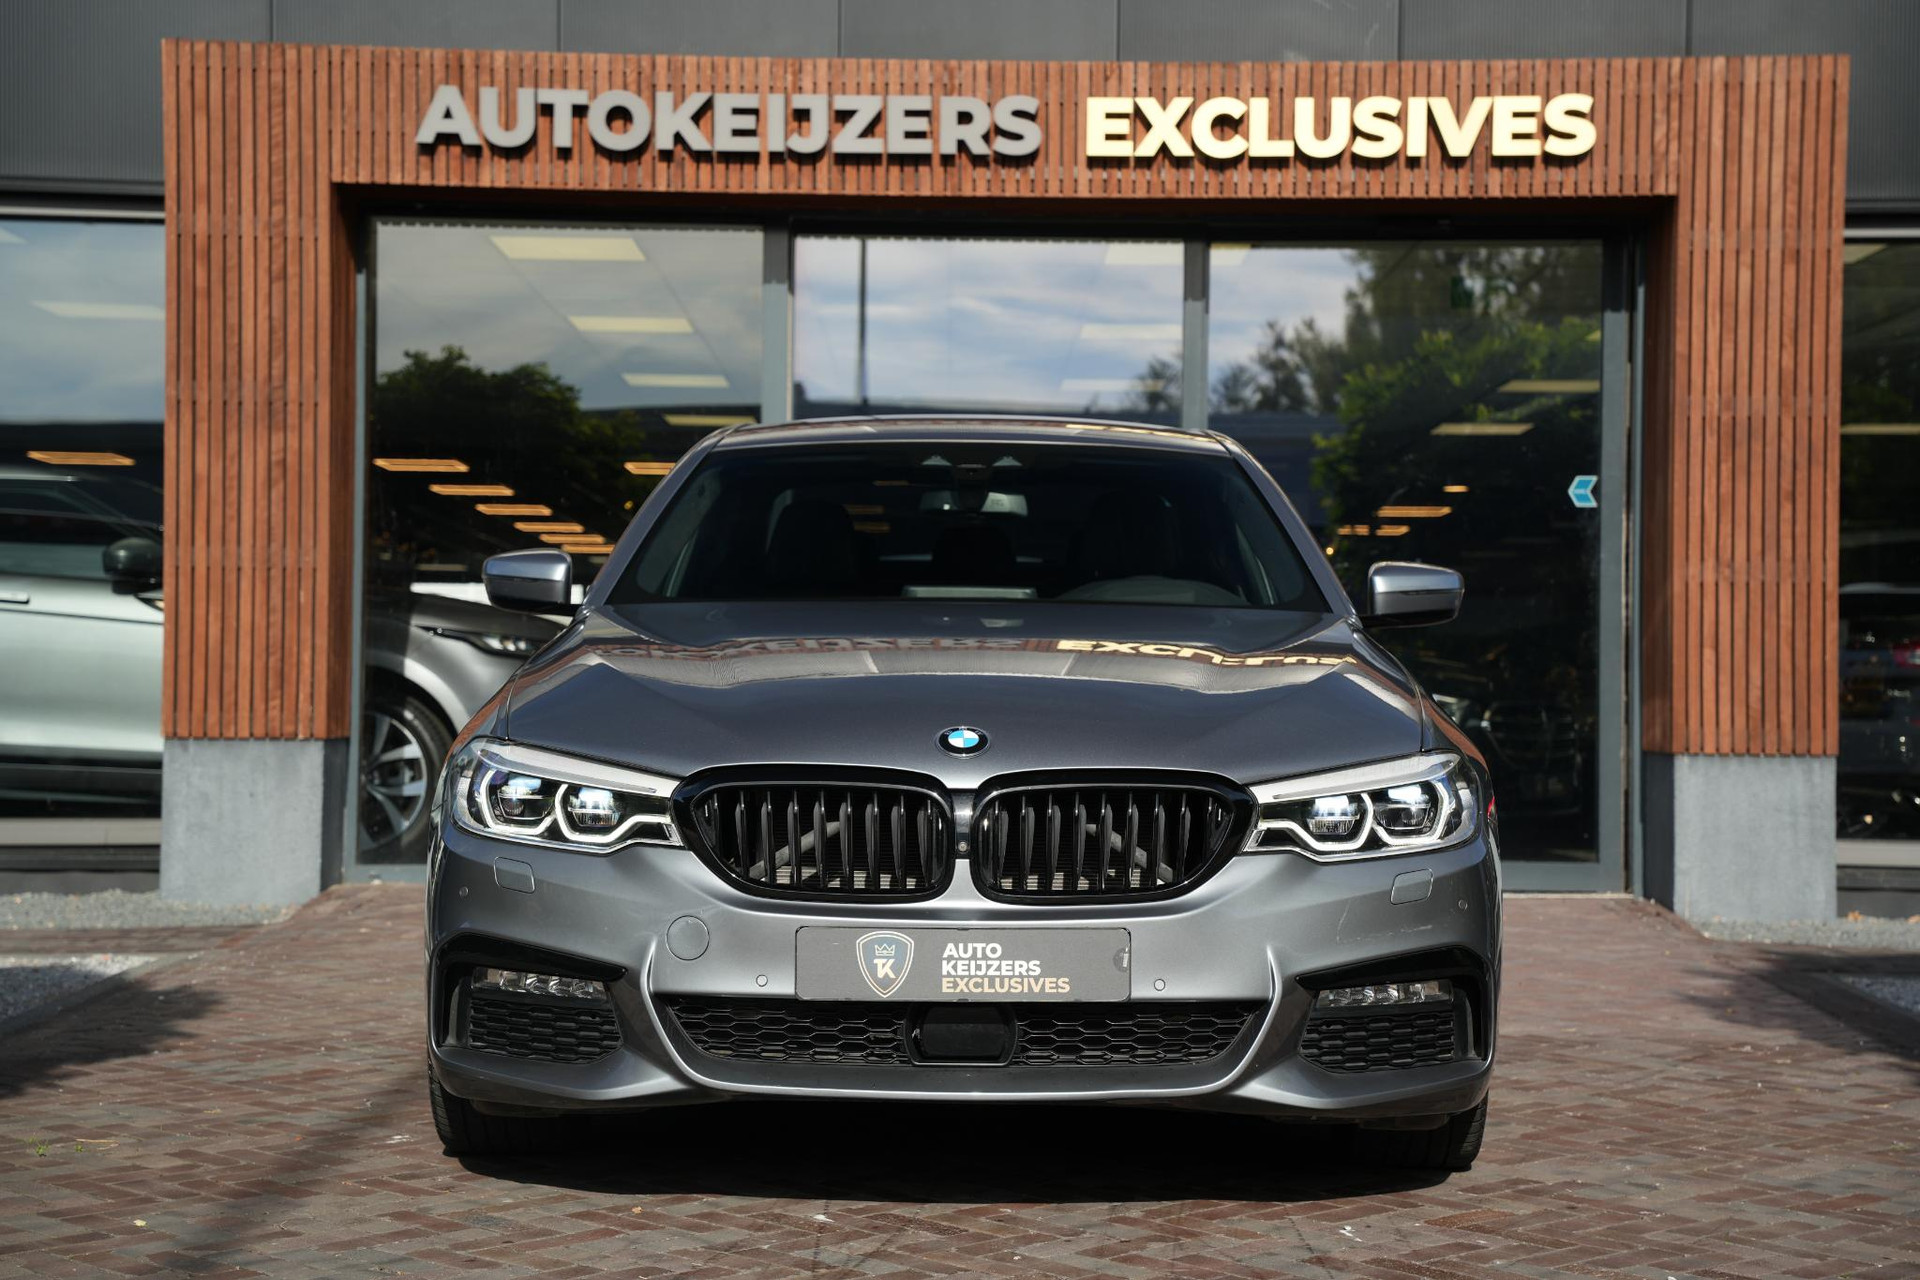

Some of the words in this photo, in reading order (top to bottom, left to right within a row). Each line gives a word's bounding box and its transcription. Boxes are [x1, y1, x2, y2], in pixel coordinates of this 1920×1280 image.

[415, 84, 1043, 158] AUTOKEIJZERS
[1086, 93, 1597, 160] EXCLUSIVES
[942, 943, 1002, 959] AUTO
[941, 960, 1041, 976] KEIJZERS
[941, 977, 1071, 993] EXCLUSIVES
